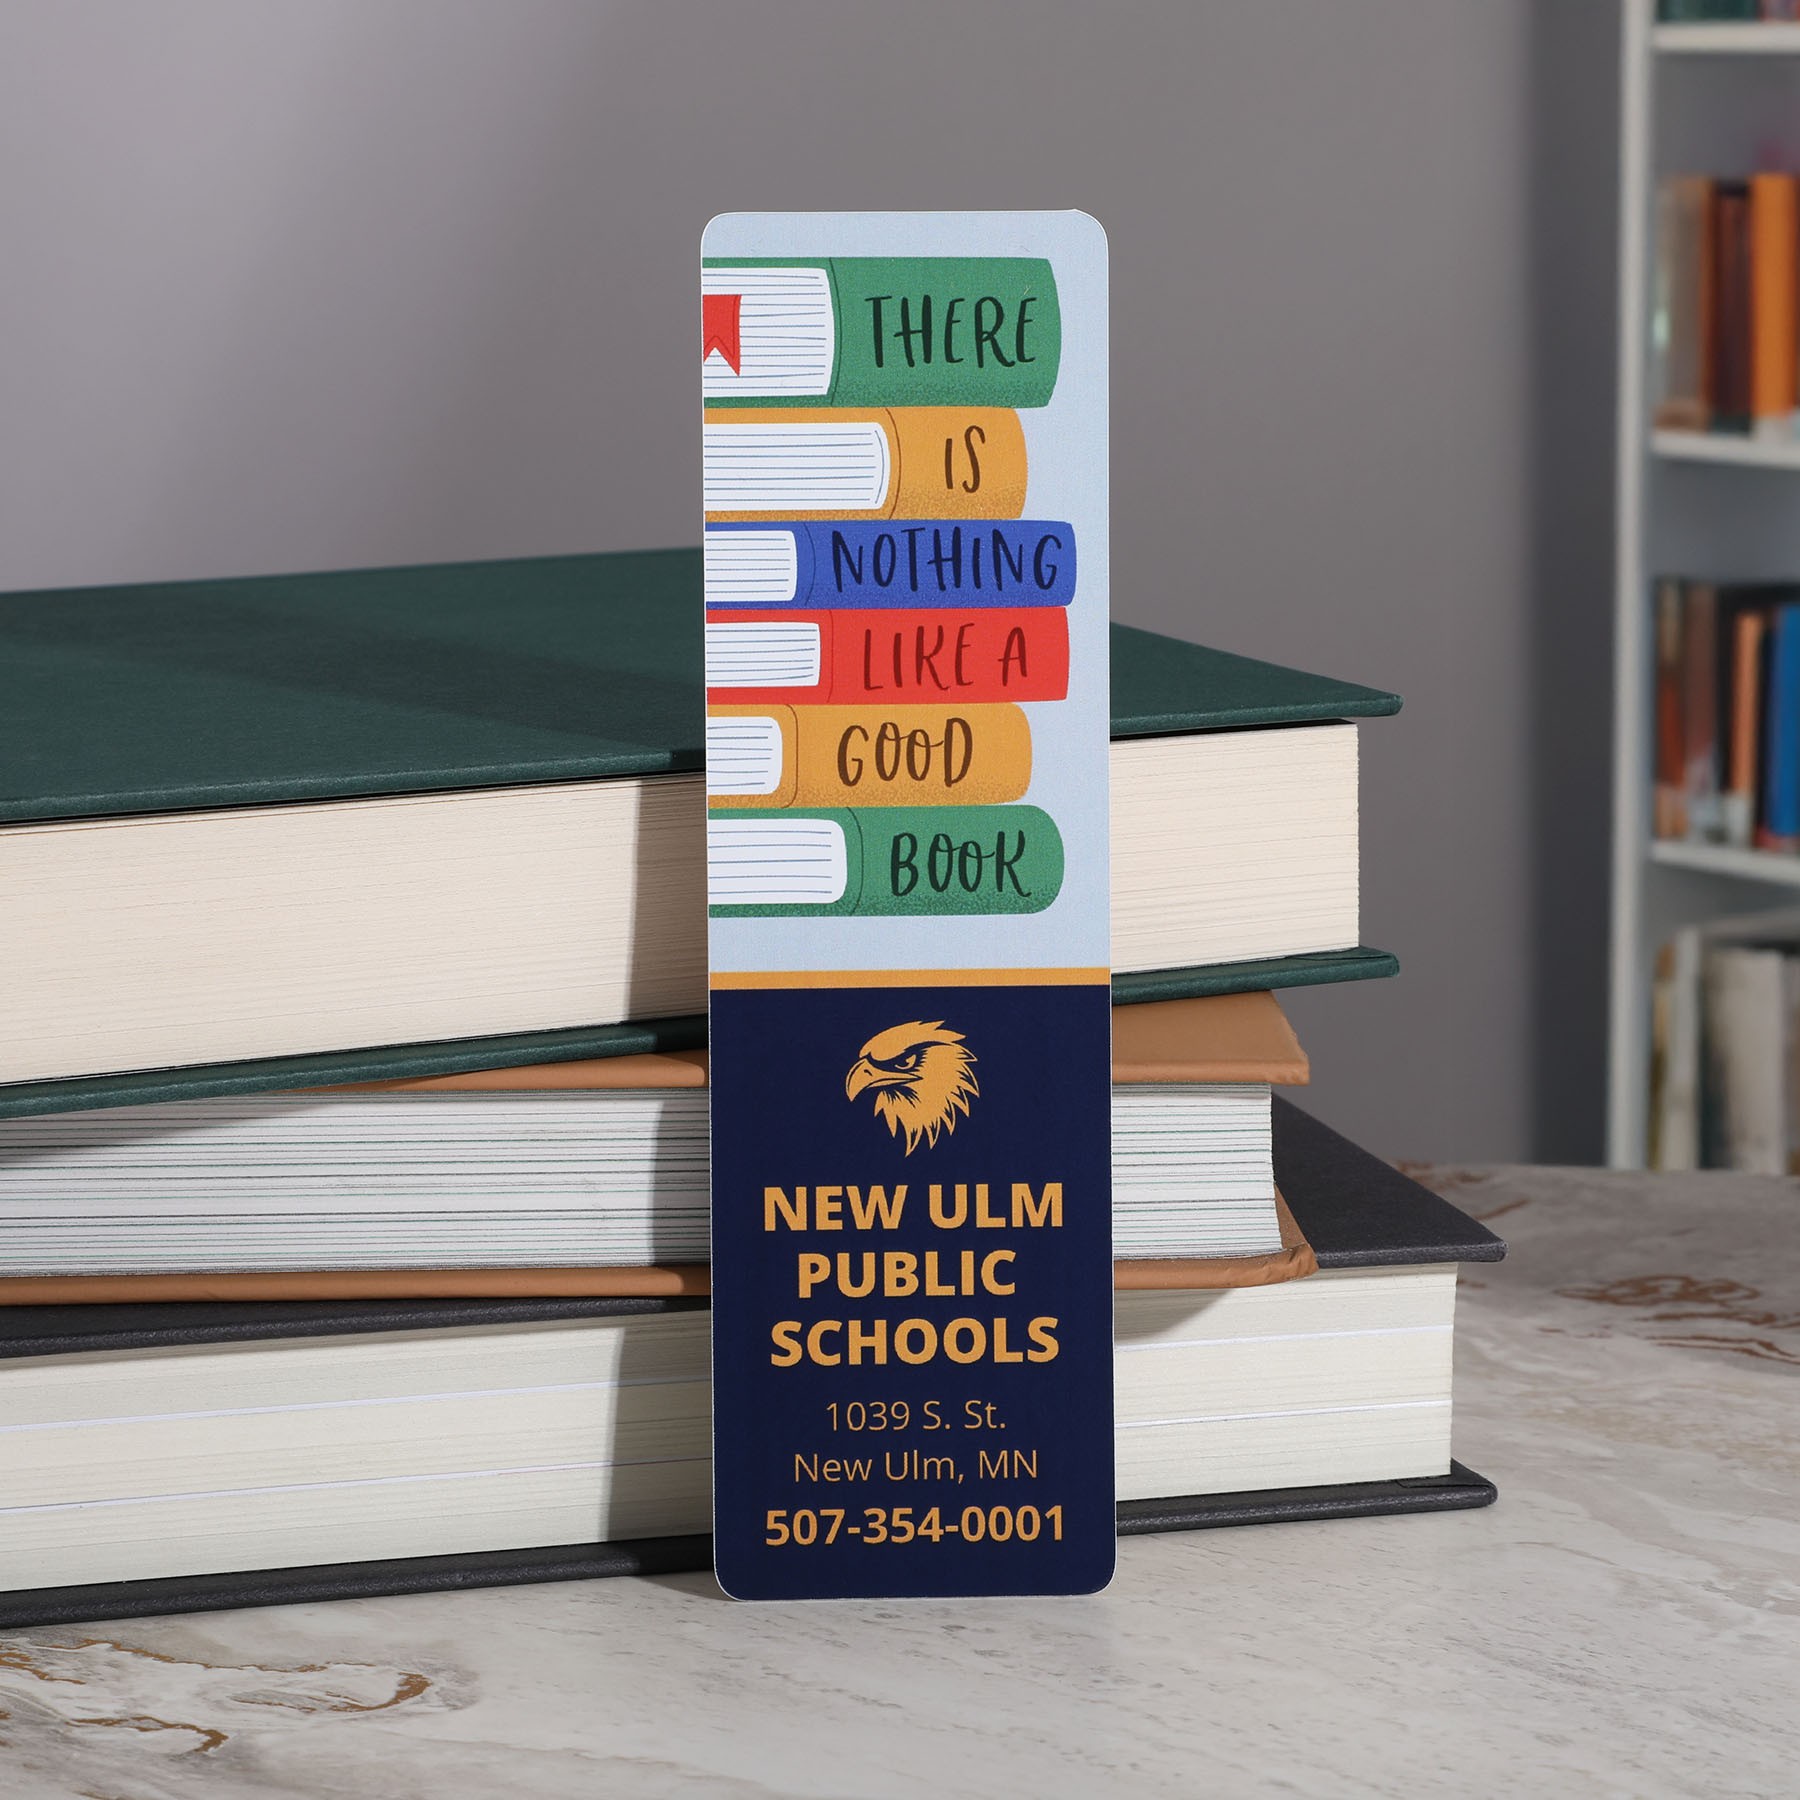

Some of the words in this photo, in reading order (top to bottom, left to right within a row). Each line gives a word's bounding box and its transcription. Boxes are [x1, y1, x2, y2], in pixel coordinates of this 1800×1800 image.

[864, 294, 1037, 368] THERE
[944, 425, 986, 493] IS
[831, 526, 1062, 593] NOTHING
[863, 622, 975, 691] LIKE
[997, 626, 1028, 687] A
[837, 717, 973, 788] GOOD
[890, 829, 1032, 898] BOOK
[763, 1184, 908, 1232] NEW
[928, 1182, 1064, 1229] ULM
[797, 1249, 1017, 1299] PUBLIC
[770, 1316, 1060, 1367] SCHOOLS
[825, 1401, 911, 1431] 1039
[922, 1400, 951, 1430] S.
[964, 1399, 1006, 1429] St.
[794, 1453, 873, 1482] New
[884, 1450, 964, 1484] Ulm,
[979, 1449, 1037, 1479] MN
[765, 1505, 1063, 1546] 507-354-0001
